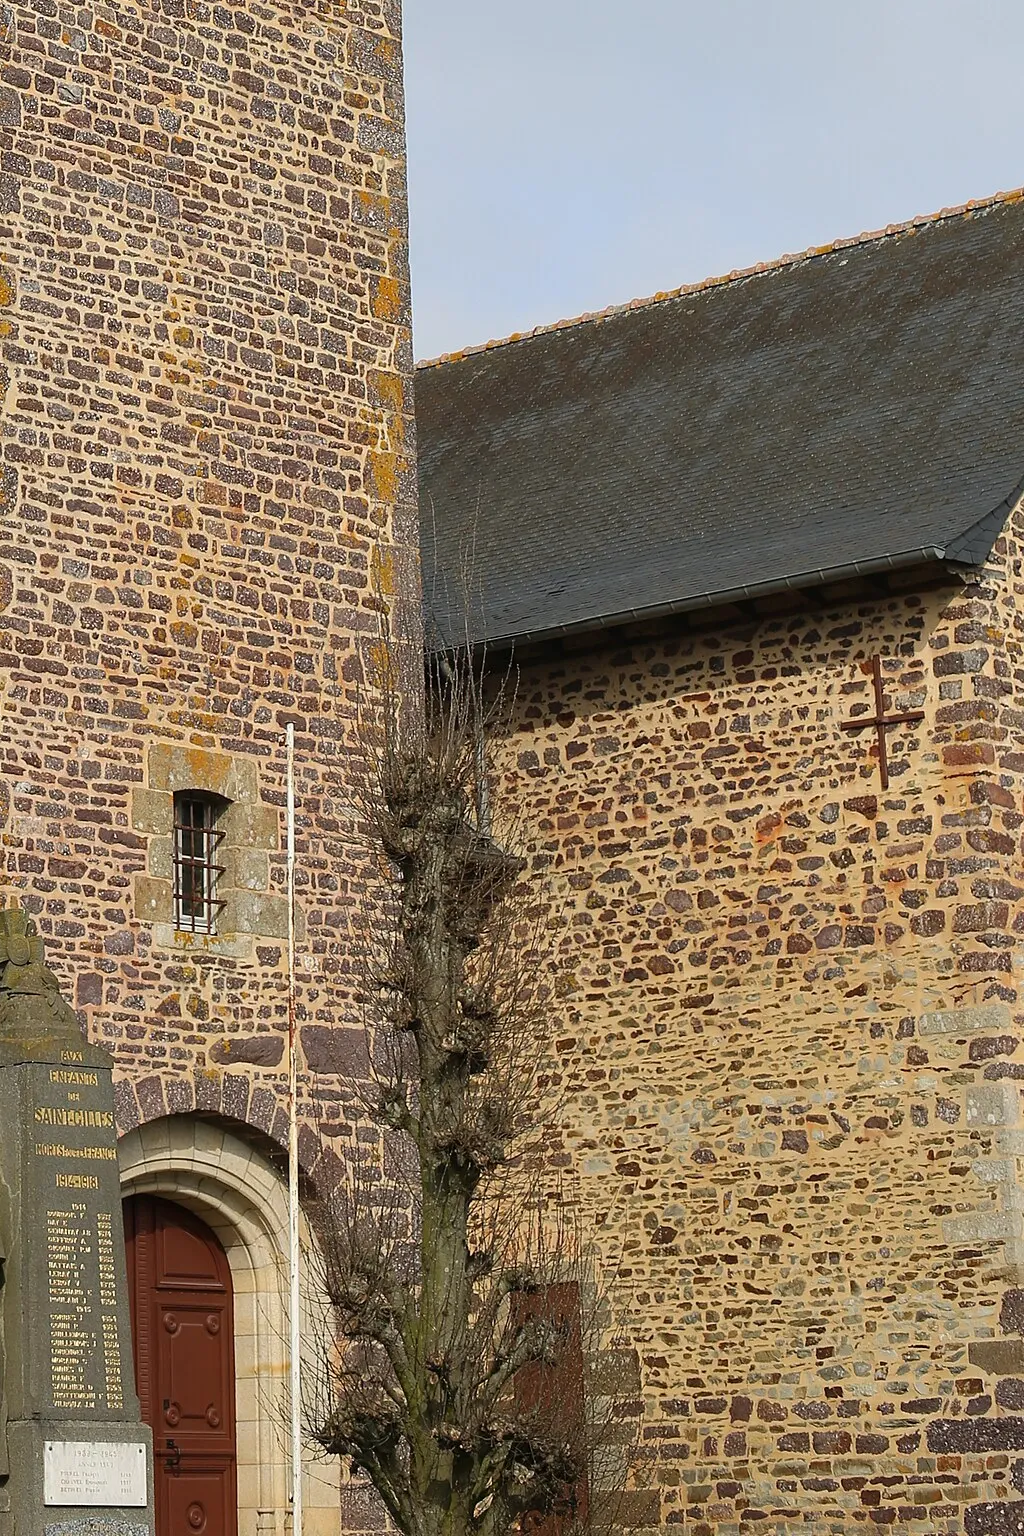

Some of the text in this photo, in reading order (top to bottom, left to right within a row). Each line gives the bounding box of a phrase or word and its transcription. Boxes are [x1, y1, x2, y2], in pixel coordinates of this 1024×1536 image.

[61, 1050, 83, 1061] AUX
[49, 1070, 98, 1085] ENFANTS
[67, 1092, 80, 1101] DE
[35, 1144, 64, 1157] MORTS
[84, 1147, 116, 1160] FRANCE
[56, 1174, 99, 1189] 1914-1918
